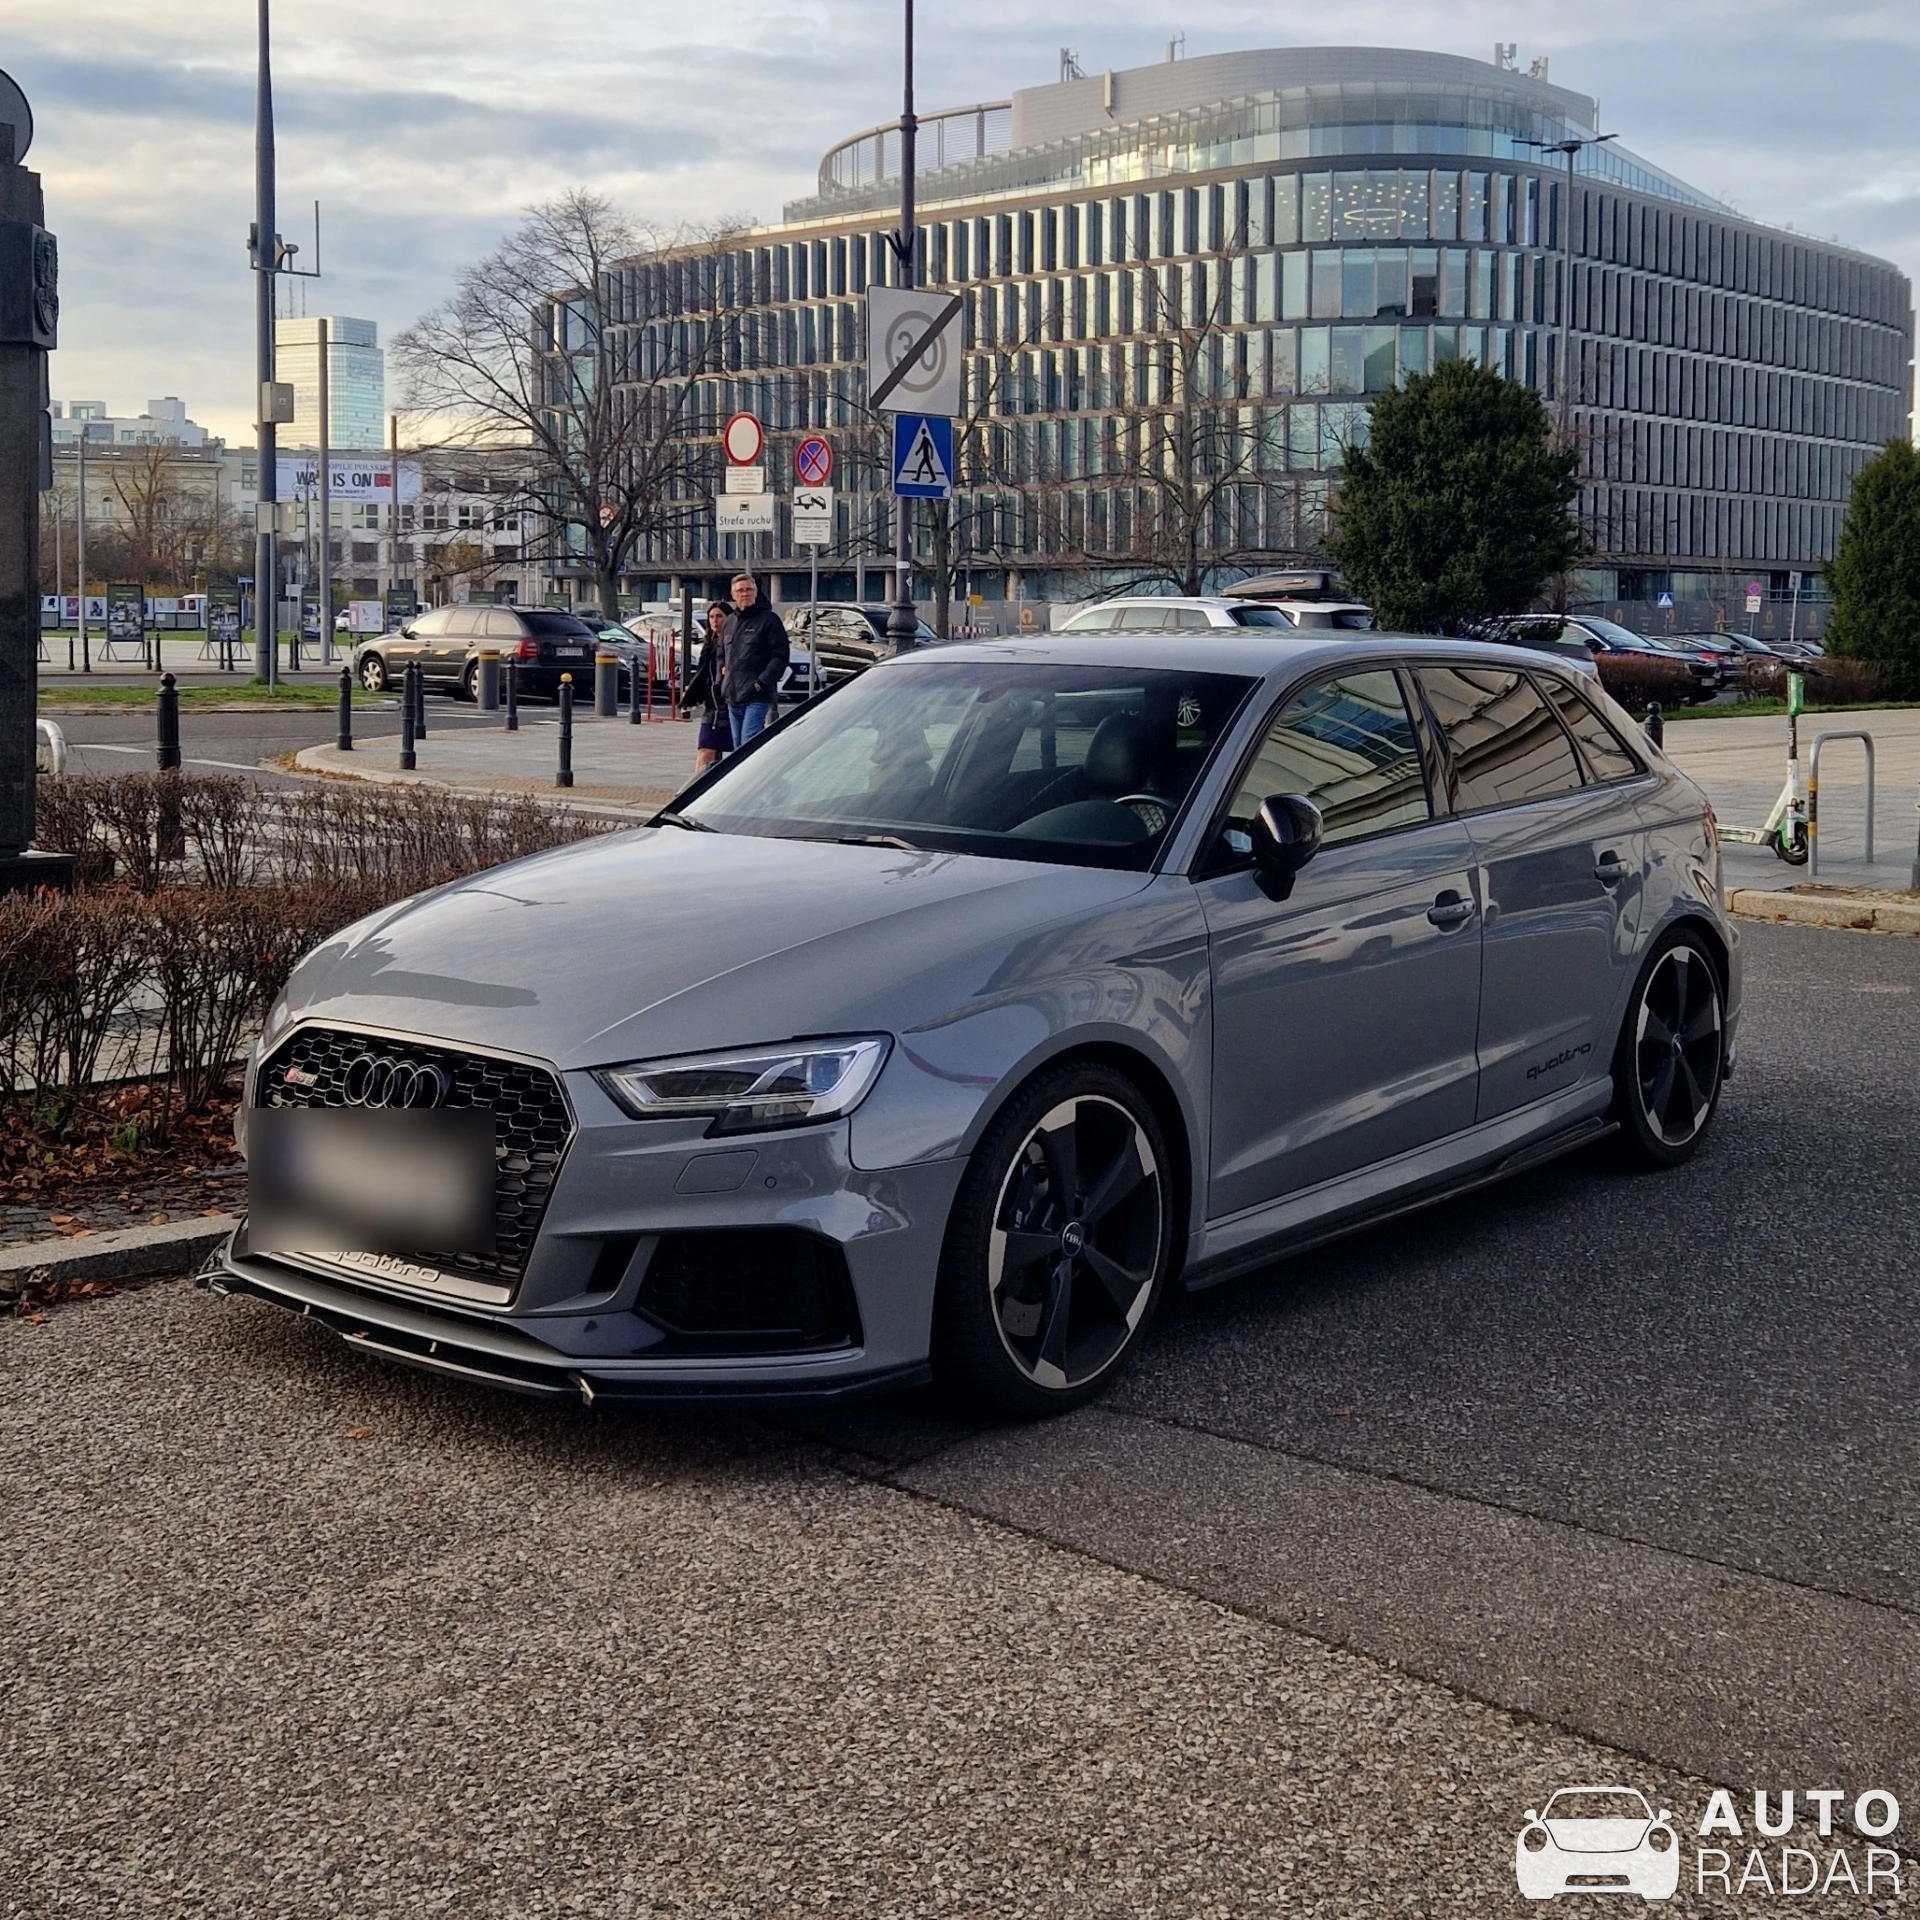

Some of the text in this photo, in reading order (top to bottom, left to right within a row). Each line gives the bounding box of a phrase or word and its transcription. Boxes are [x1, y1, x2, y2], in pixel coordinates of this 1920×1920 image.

[896, 331, 938, 372] 30
[296, 471, 372, 487] WA IS ON
[719, 515, 771, 526] Strefa ruchu
[1526, 1042, 1591, 1080] quattro
